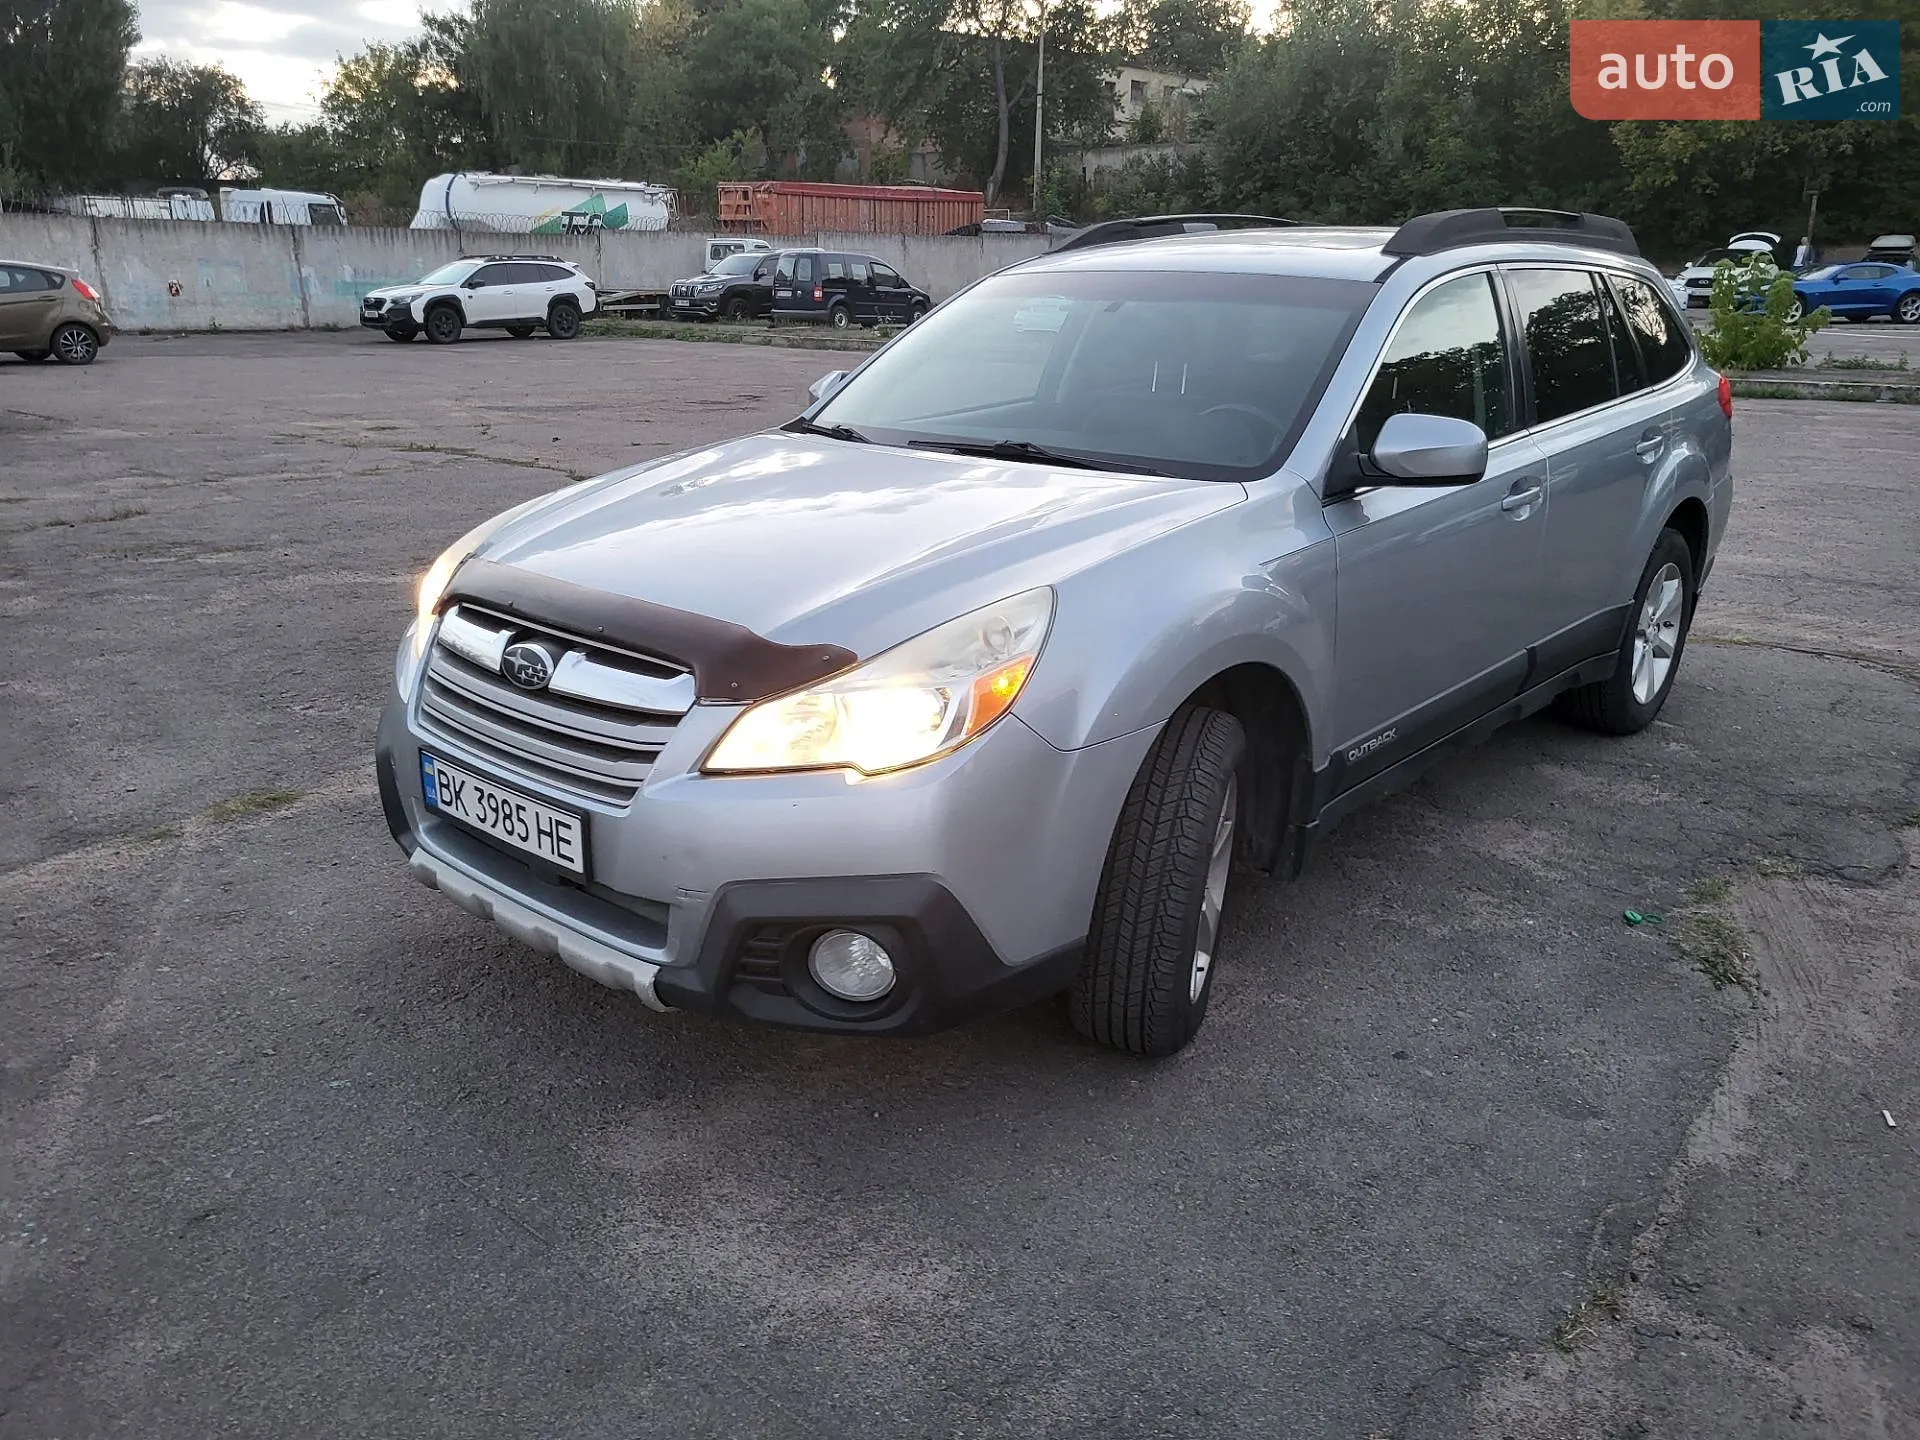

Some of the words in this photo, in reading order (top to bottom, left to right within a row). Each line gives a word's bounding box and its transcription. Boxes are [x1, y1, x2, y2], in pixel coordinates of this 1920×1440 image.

[1348, 728, 1396, 761] OUTBACK
[437, 768, 469, 816] BK
[475, 787, 529, 842] 3985
[535, 812, 575, 864] HE
